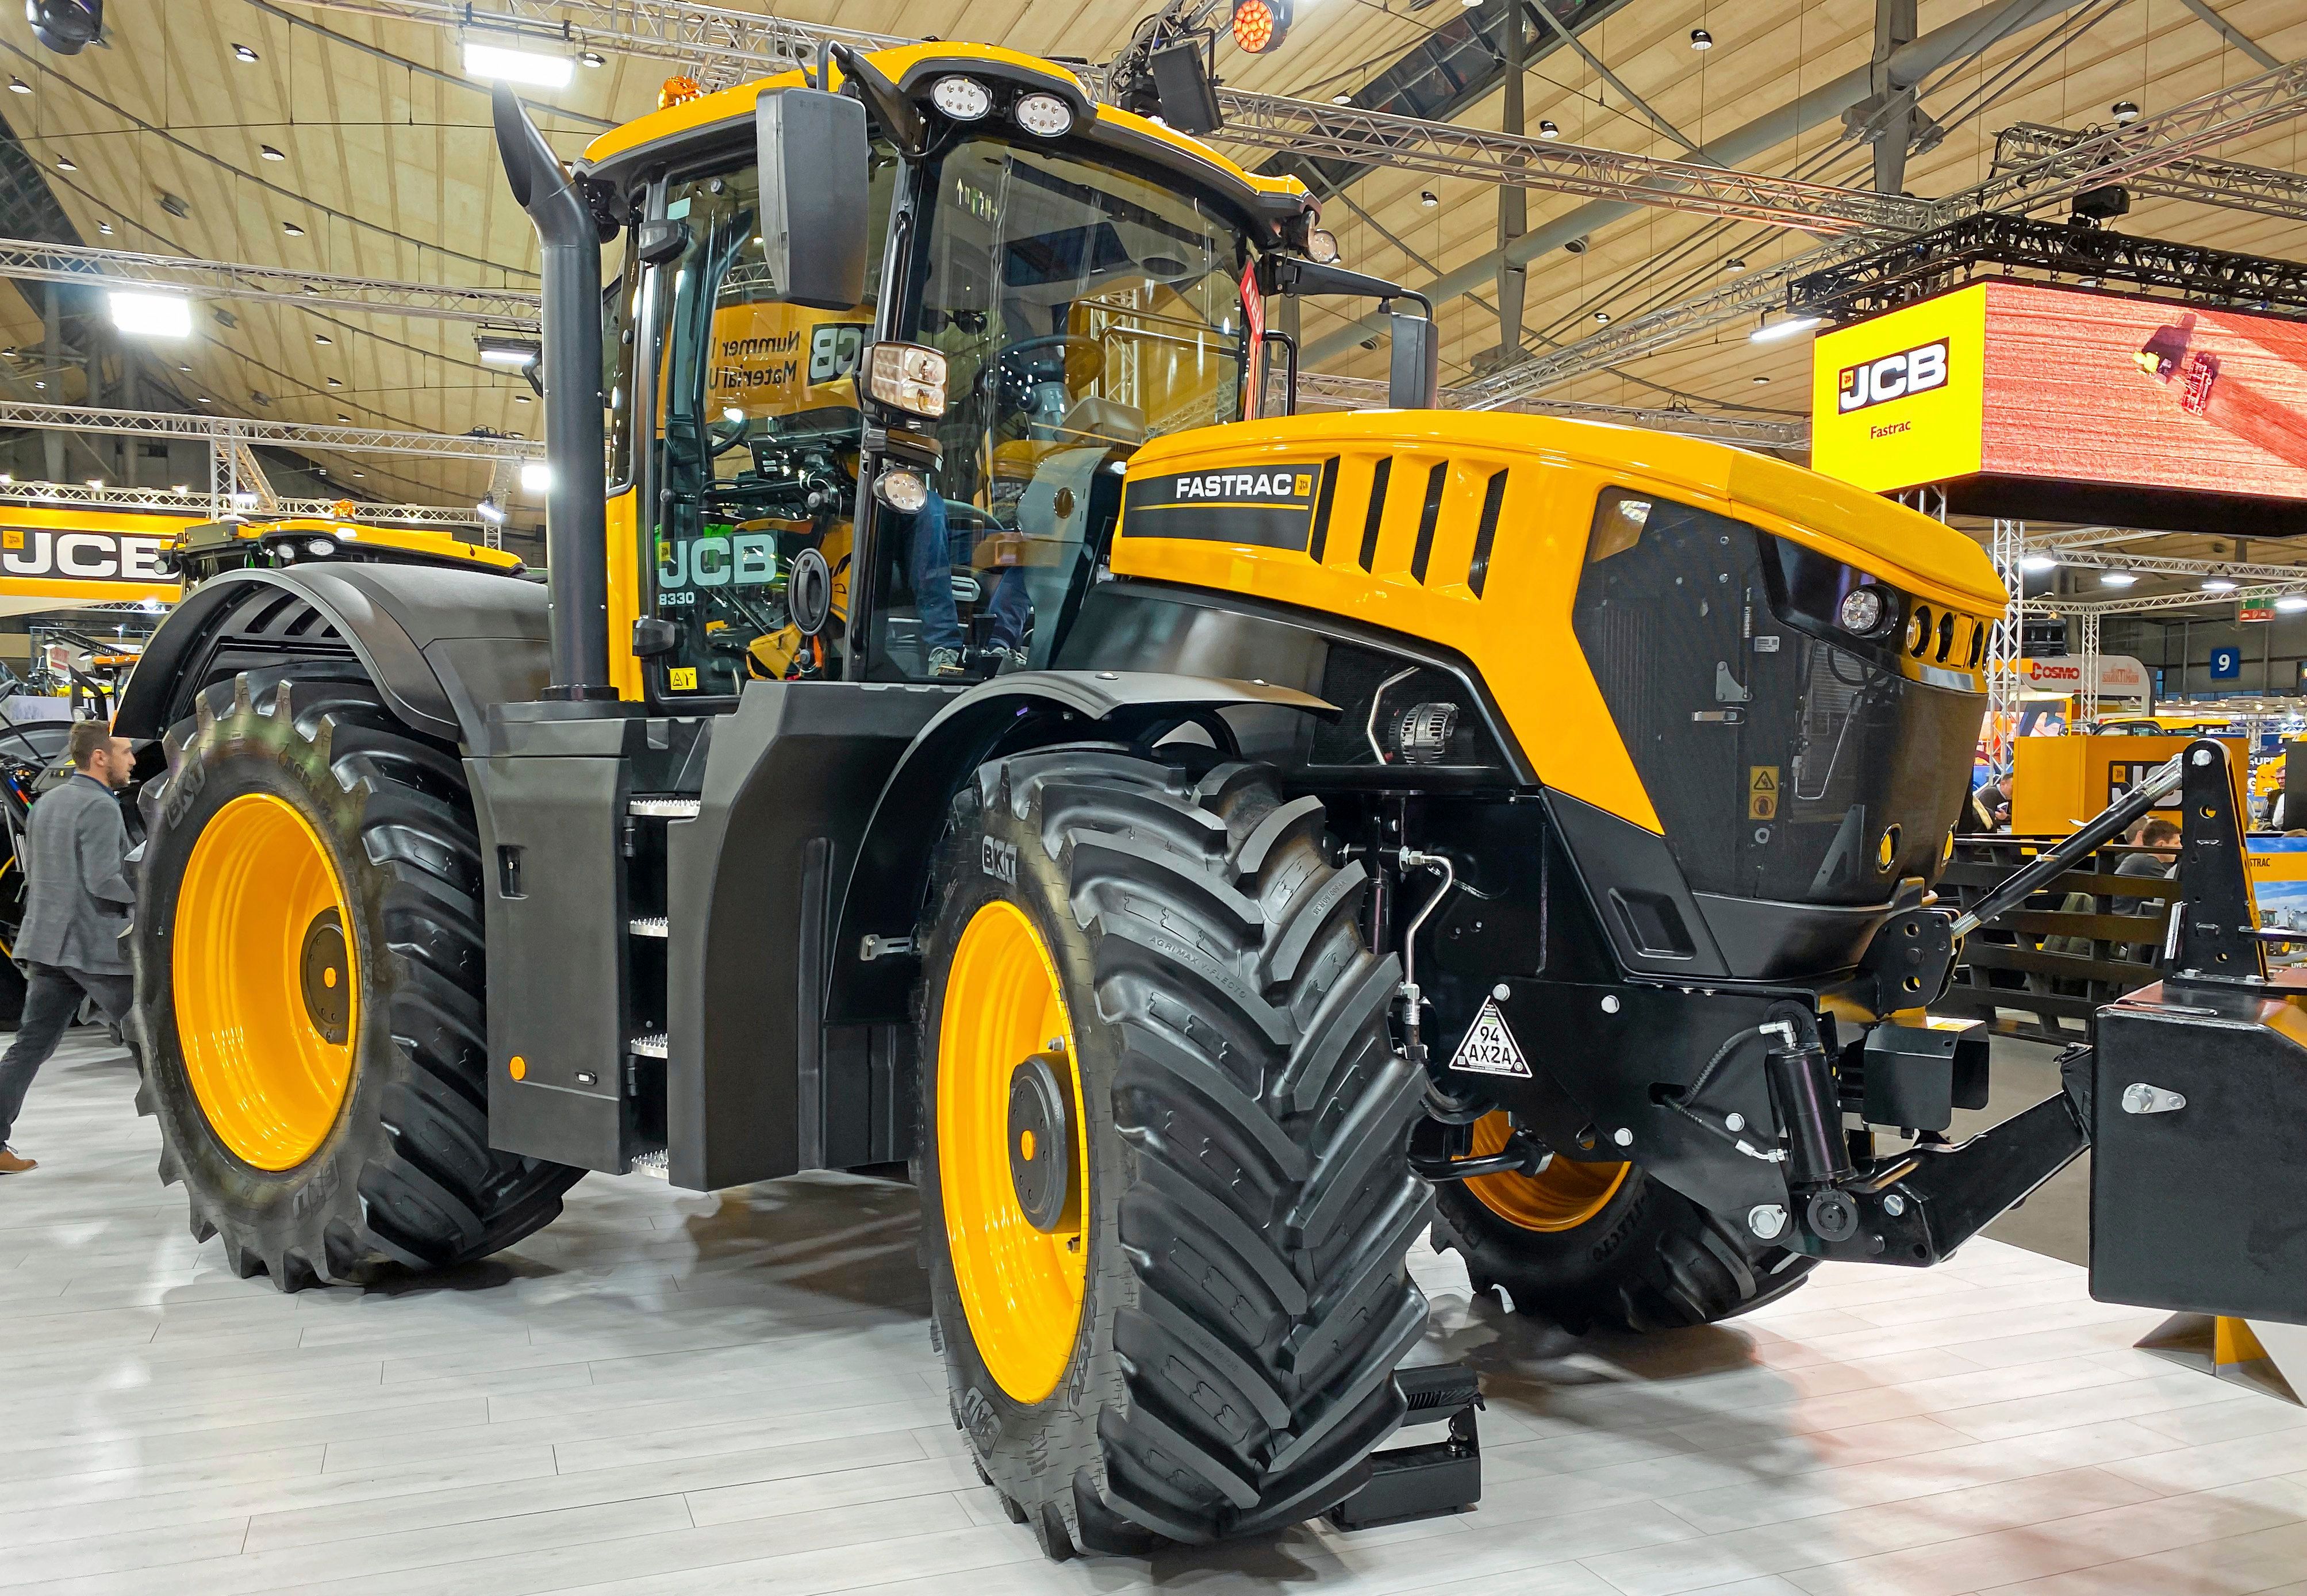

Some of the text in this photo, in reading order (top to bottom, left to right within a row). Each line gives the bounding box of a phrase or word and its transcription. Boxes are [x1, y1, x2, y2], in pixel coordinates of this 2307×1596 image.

[1246, 277, 1262, 335] NEU
[1840, 343, 1946, 410] JCB
[1870, 421, 1911, 439] Fastrac
[1176, 473, 1292, 498] FASTRAC
[659, 534, 777, 588] JCB
[659, 592, 695, 605] 8330
[2030, 662, 2080, 681] COSMO
[2218, 654, 2231, 672] 9
[982, 835, 1017, 884] BKT
[1480, 1026, 1499, 1044] 94
[1469, 1044, 1511, 1065] AX2A
